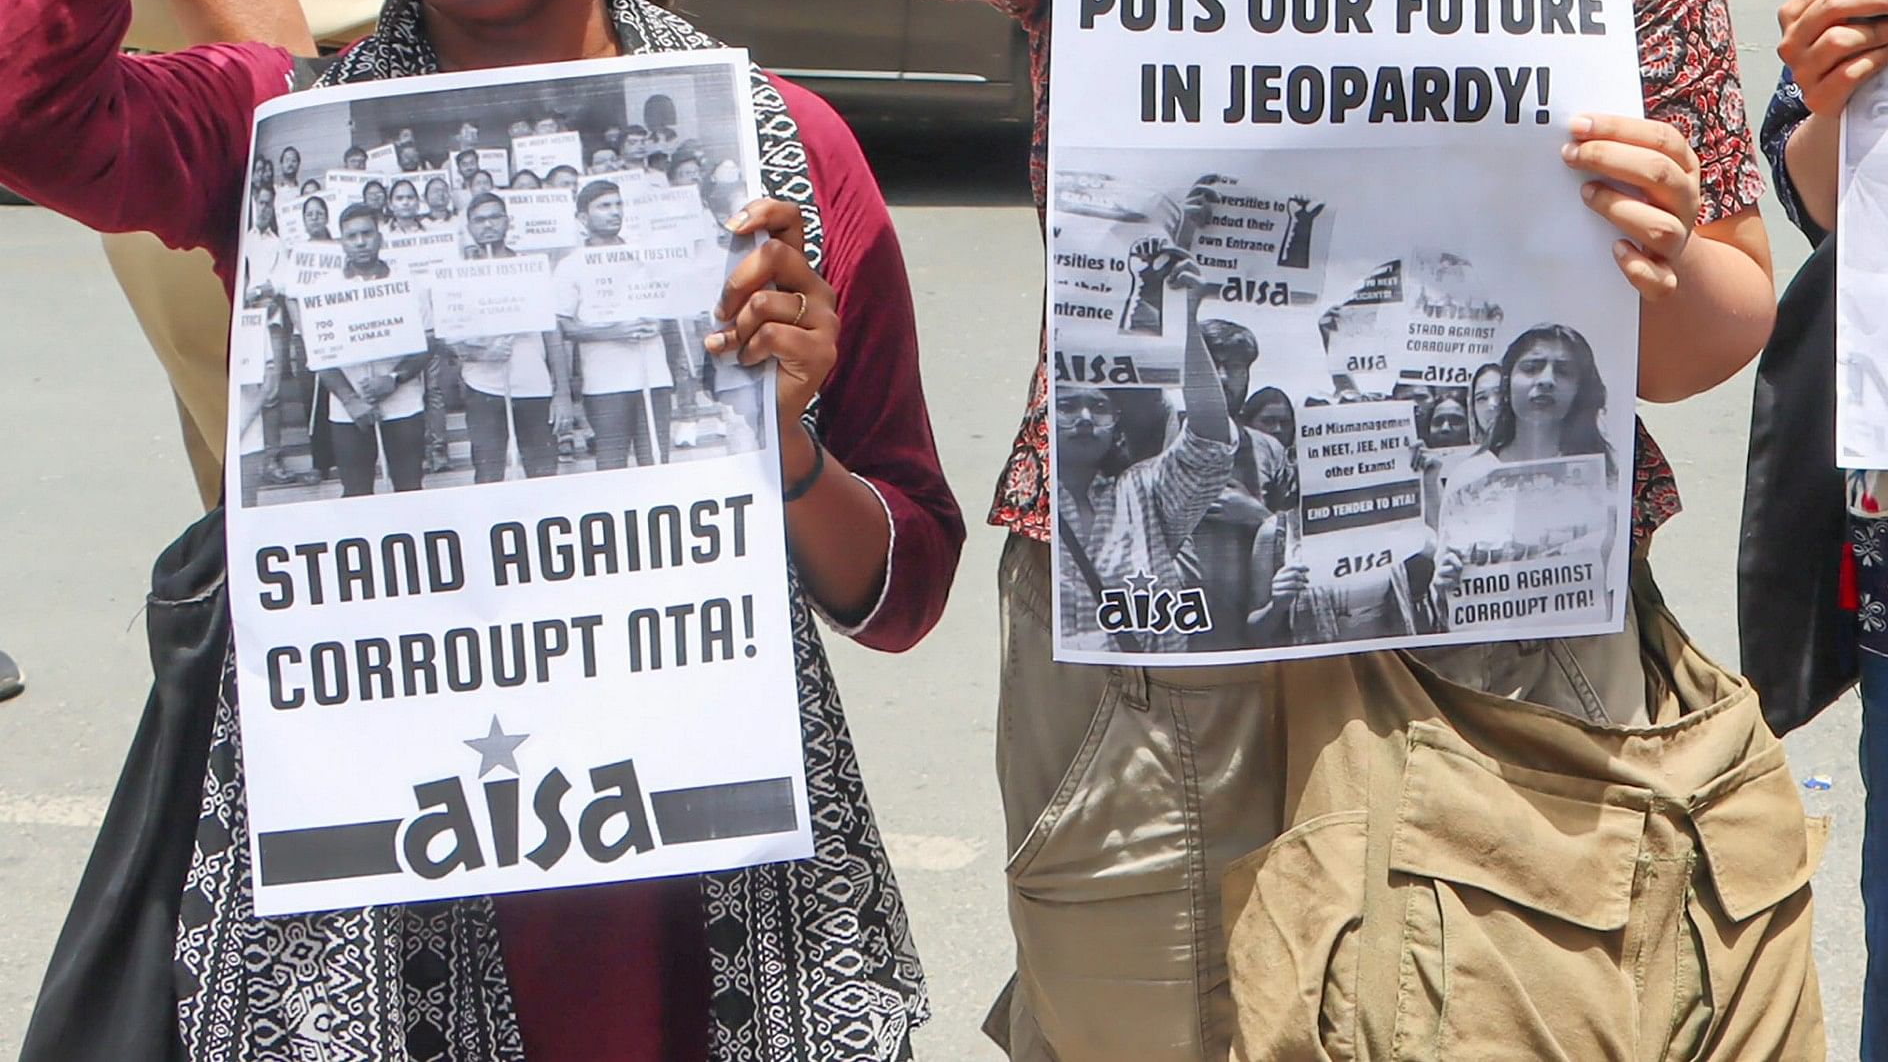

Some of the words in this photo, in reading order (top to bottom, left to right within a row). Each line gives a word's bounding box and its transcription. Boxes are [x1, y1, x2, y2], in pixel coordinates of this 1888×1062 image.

[1140, 63, 1202, 124] IN
[1222, 64, 1551, 126] JEOPARDY!
[1273, 199, 1286, 212] to
[1247, 218, 1275, 232] their
[606, 250, 640, 263] WANT
[644, 246, 688, 260] JUSTICE
[1226, 236, 1275, 253] Entrance
[1055, 253, 1105, 271] rsities
[1110, 255, 1125, 272] to
[1197, 254, 1238, 270] Exams!
[304, 294, 323, 309] WE
[324, 289, 359, 305] WANT
[363, 281, 411, 299] JUSTICE
[1222, 276, 1289, 306] aisa
[1054, 301, 1113, 320] ntrance
[1409, 322, 1445, 335] STAND
[1448, 324, 1495, 339] AGAINST
[1347, 355, 1387, 371] aisa
[1424, 366, 1468, 383] aisa
[1301, 424, 1322, 437] End
[1308, 447, 1319, 459] in
[1381, 437, 1400, 450] NET
[1325, 465, 1354, 479] other
[1358, 459, 1395, 474] Exams!
[1307, 508, 1330, 520] END
[1333, 500, 1373, 516] TENDER
[1376, 498, 1389, 510] TO
[1392, 493, 1416, 508] NTA!
[255, 529, 464, 611] STAND
[490, 494, 755, 587] AGAINST
[1334, 549, 1392, 578] aisa
[1517, 563, 1593, 590] AGAINST
[1100, 589, 1211, 632] aisa
[1454, 596, 1548, 626] CORROUPT
[1555, 589, 1594, 611] NTA!
[266, 615, 603, 711] CORROUPT
[628, 594, 760, 673] NTA!
[403, 759, 656, 881] aisa
